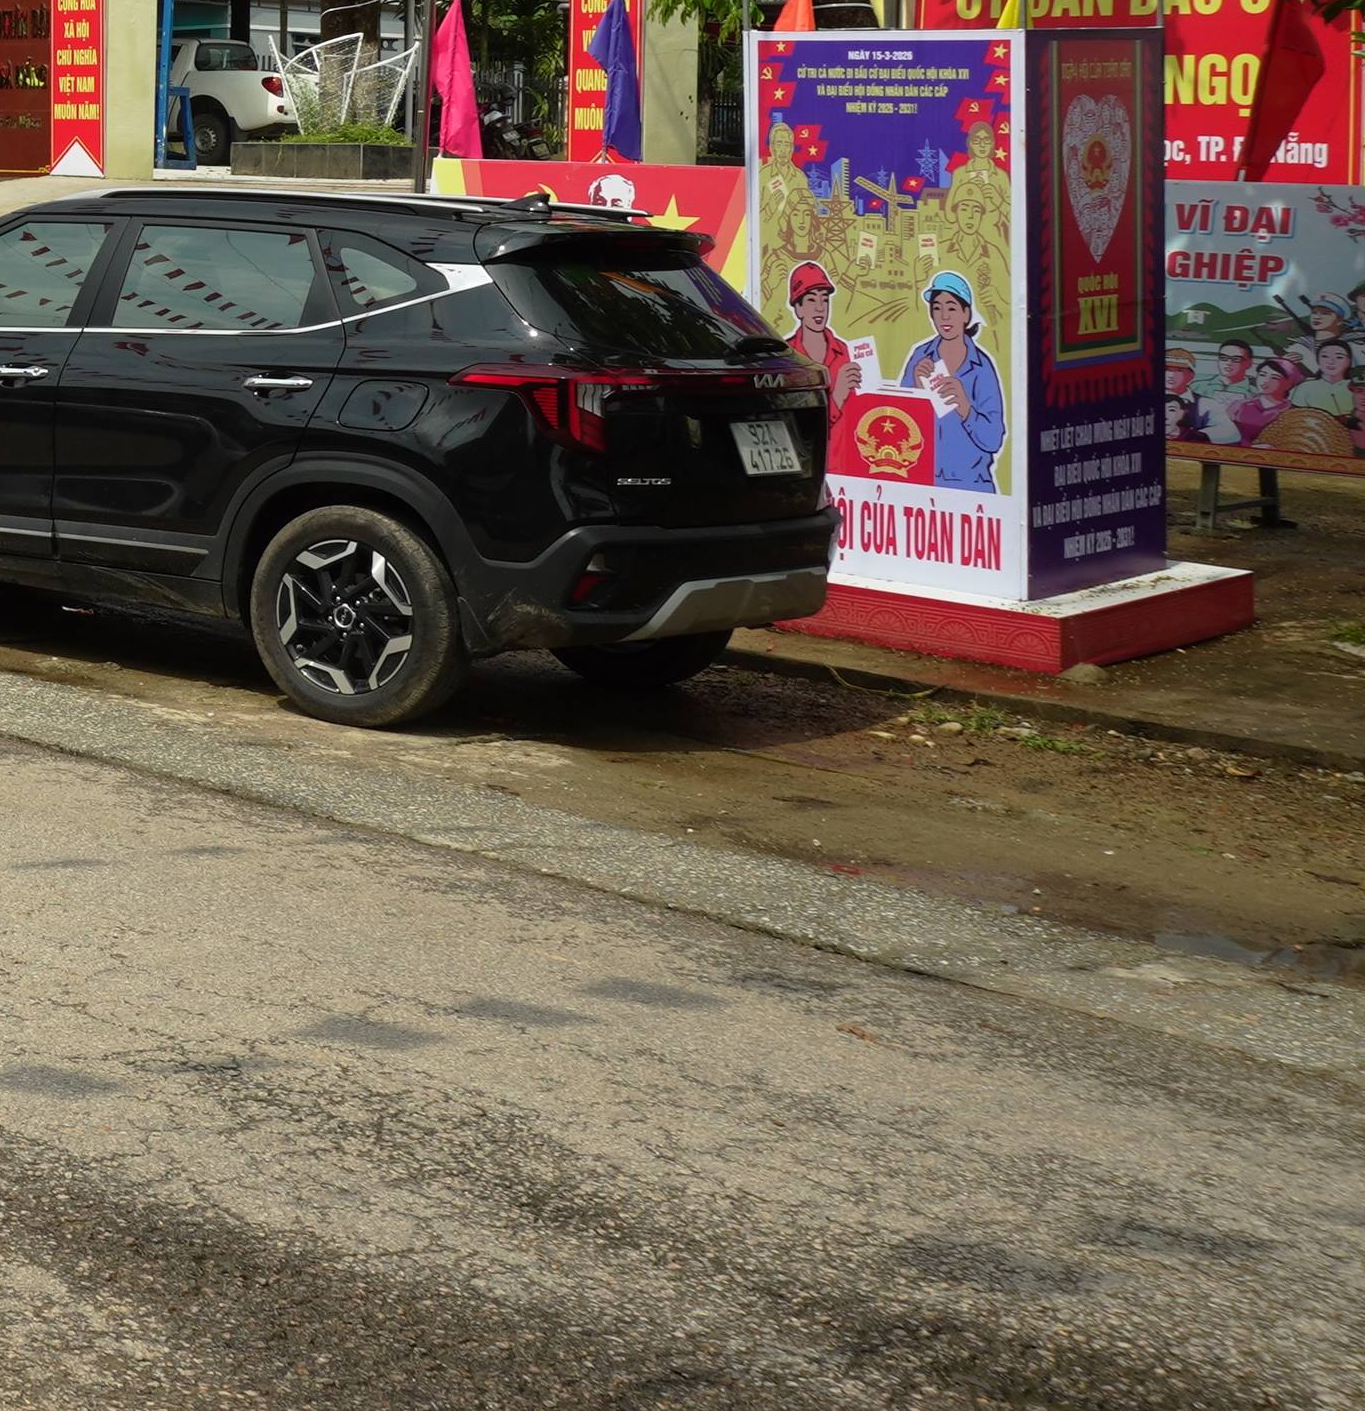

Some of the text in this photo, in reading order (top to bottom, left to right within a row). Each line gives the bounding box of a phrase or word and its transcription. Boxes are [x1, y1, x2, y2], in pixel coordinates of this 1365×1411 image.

[64, 18, 74, 38] XÃ
[76, 19, 89, 41] HỘI
[57, 44, 97, 66] CHỦ NGHĨA
[847, 49, 869, 60] NGÀY
[59, 73, 75, 96] VIỆT
[76, 76, 95, 93] NAM
[576, 69, 608, 93] QUANG
[1164, 53, 1262, 117] NGỌ
[54, 100, 100, 120] MUÔN NĂM!
[574, 103, 604, 130] MUÔN
[1197, 135, 1227, 162] TP.
[1174, 198, 1292, 240] VĨ ĐẠI
[1167, 248, 1285, 288] GHIỆP
[1077, 294, 1119, 335] XVI
[750, 447, 794, 472] 417.26
[616, 477, 671, 486] SELTOS
[832, 484, 1001, 571] ỘI CỦA TOÀN DÂN
